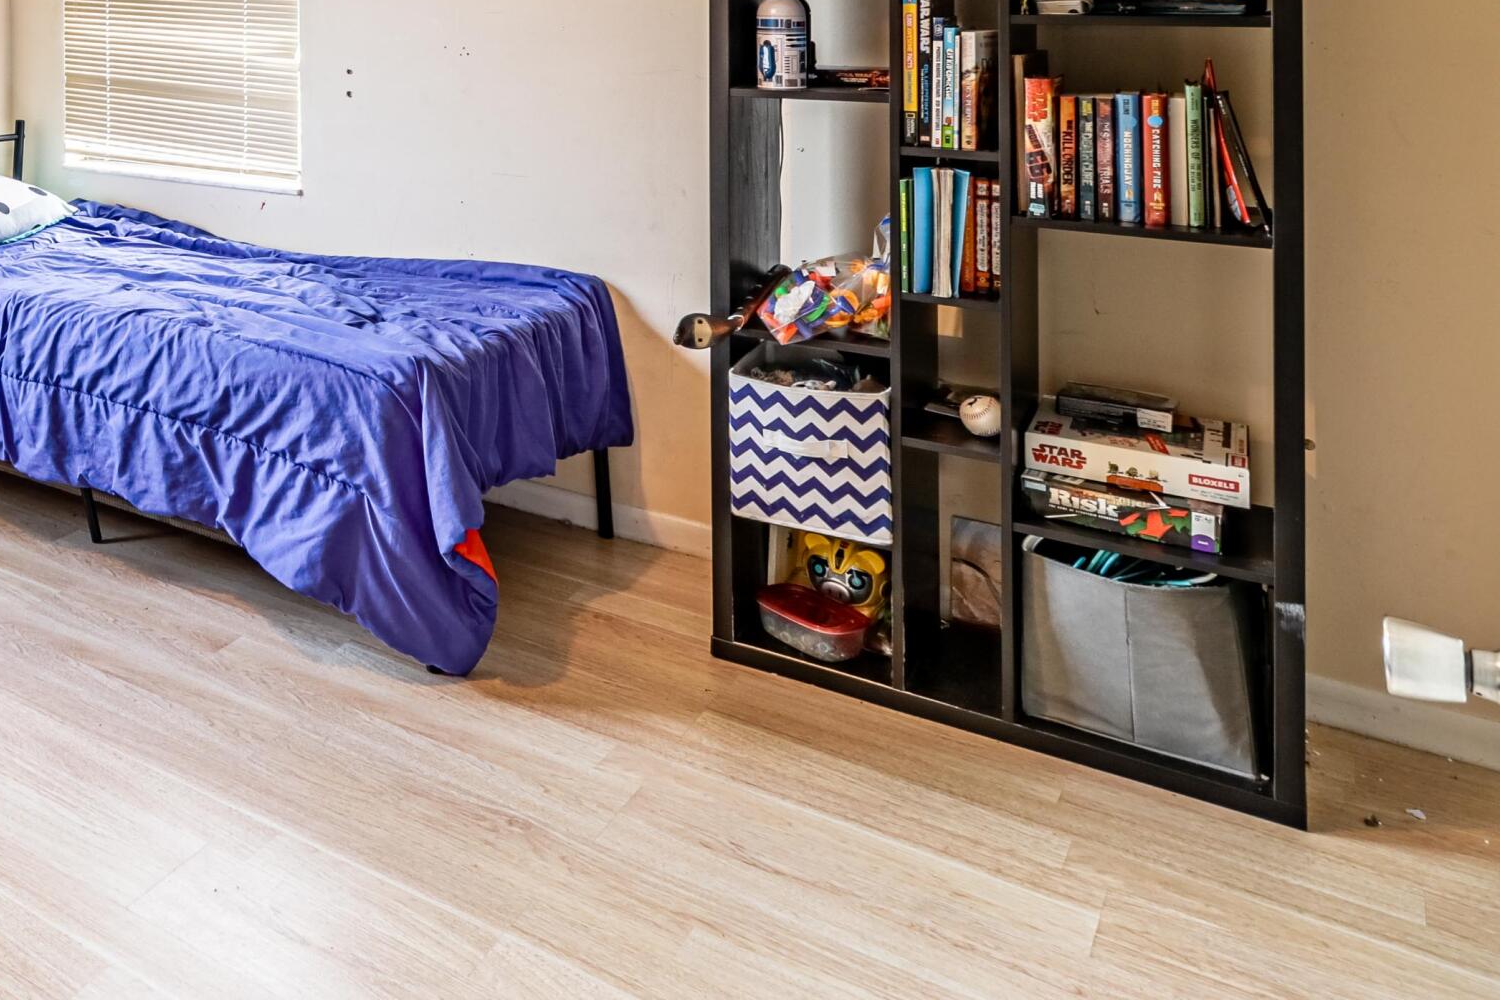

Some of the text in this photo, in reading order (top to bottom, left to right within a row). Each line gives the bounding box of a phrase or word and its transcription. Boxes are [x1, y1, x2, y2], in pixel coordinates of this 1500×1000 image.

[920, 18, 930, 54] WARS
[1062, 131, 1074, 152] KILL
[1062, 153, 1074, 185] ORDER
[1123, 131, 1132, 186] MOCKINGJAY
[1152, 129, 1161, 189] CATCHING FIRE
[1082, 162, 1094, 186] CURE
[1100, 166, 1111, 194] TRIALS
[1031, 443, 1087, 461] STAR
[1033, 453, 1087, 470] WARS
[1191, 476, 1236, 490] BLOXELS
